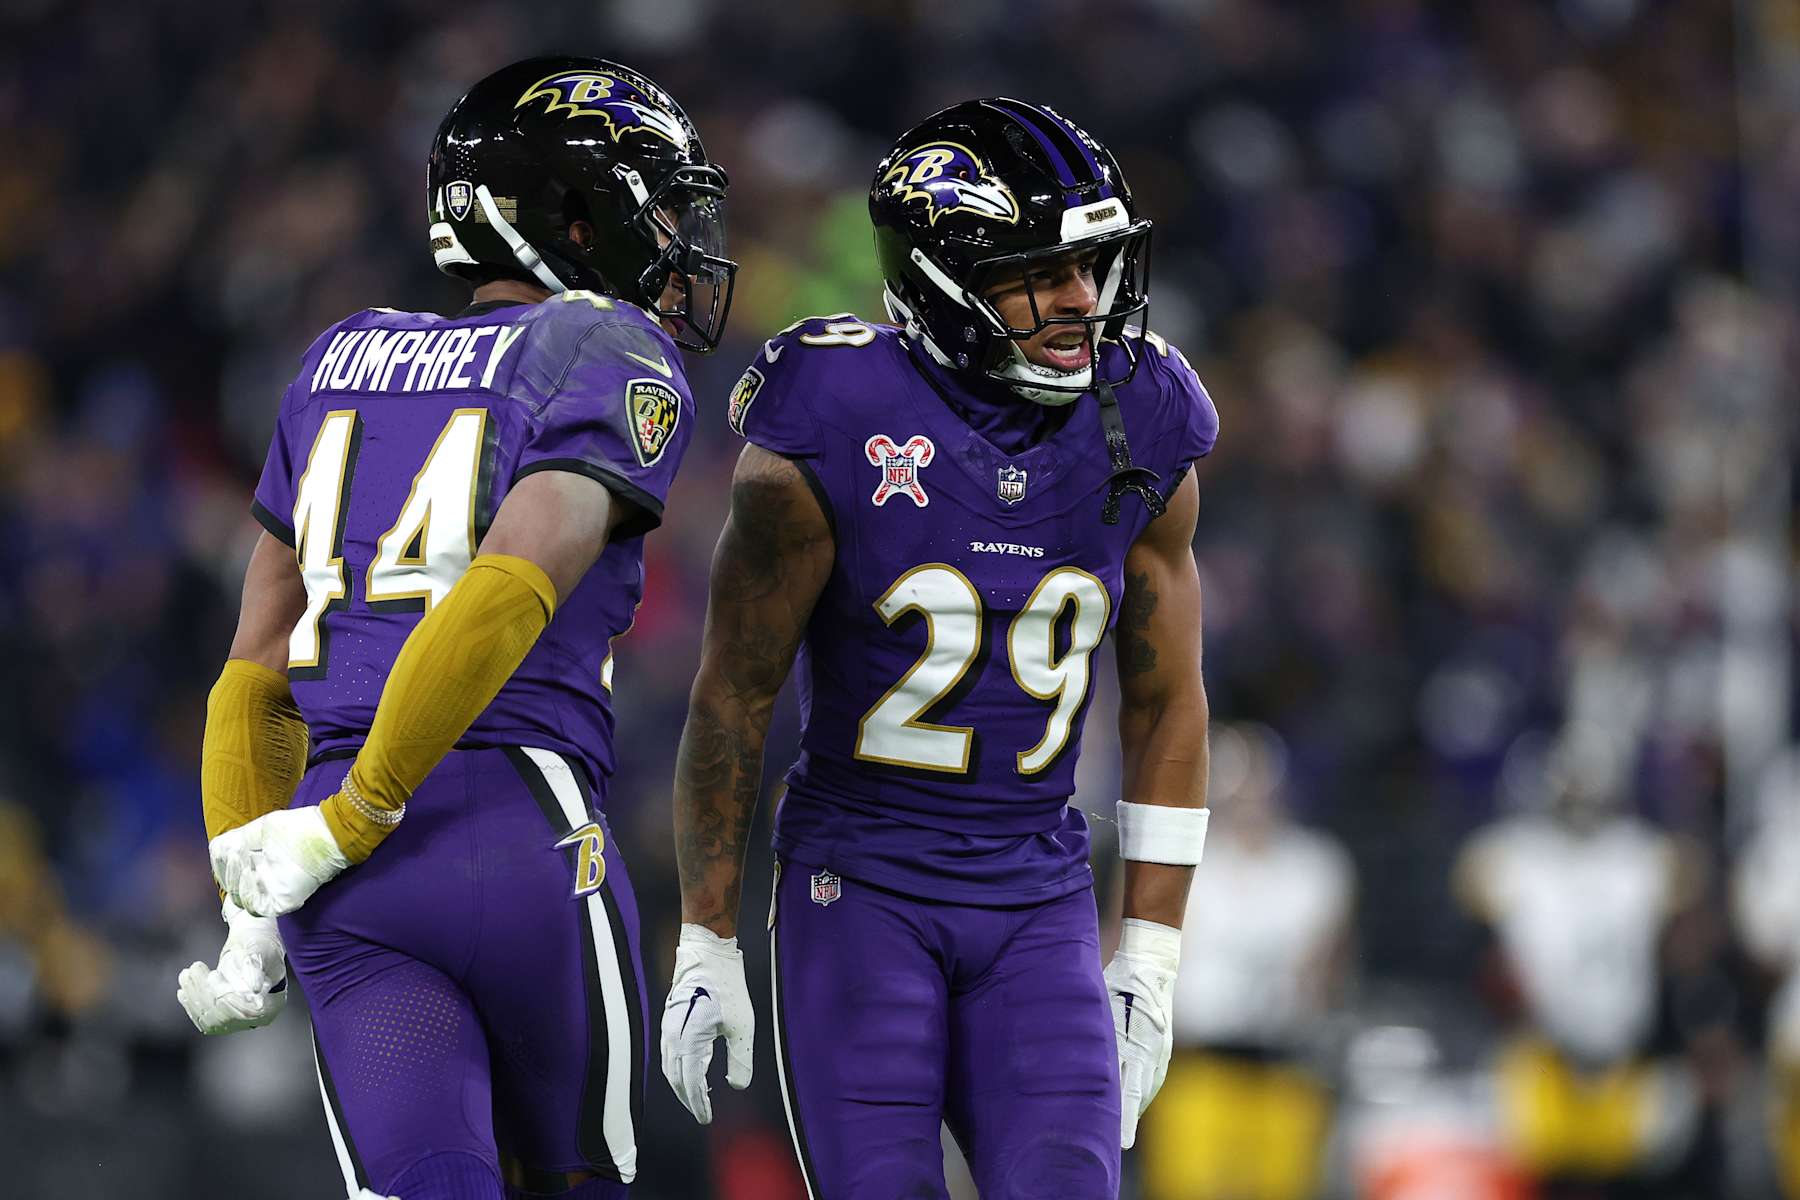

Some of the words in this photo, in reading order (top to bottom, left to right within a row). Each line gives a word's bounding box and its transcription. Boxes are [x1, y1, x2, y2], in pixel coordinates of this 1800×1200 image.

[553, 75, 615, 102] B
[908, 149, 955, 184] B
[1084, 206, 1117, 224] RAVENS
[311, 326, 526, 393] HUMPHREY
[634, 385, 677, 406] RAVENS
[888, 468, 912, 483] NFL
[1001, 481, 1022, 498] NFL
[288, 408, 488, 668] 44
[970, 541, 1044, 558] RAVENS
[854, 562, 1111, 775] 29
[553, 823, 606, 895] B
[816, 885, 838, 899] NFL
